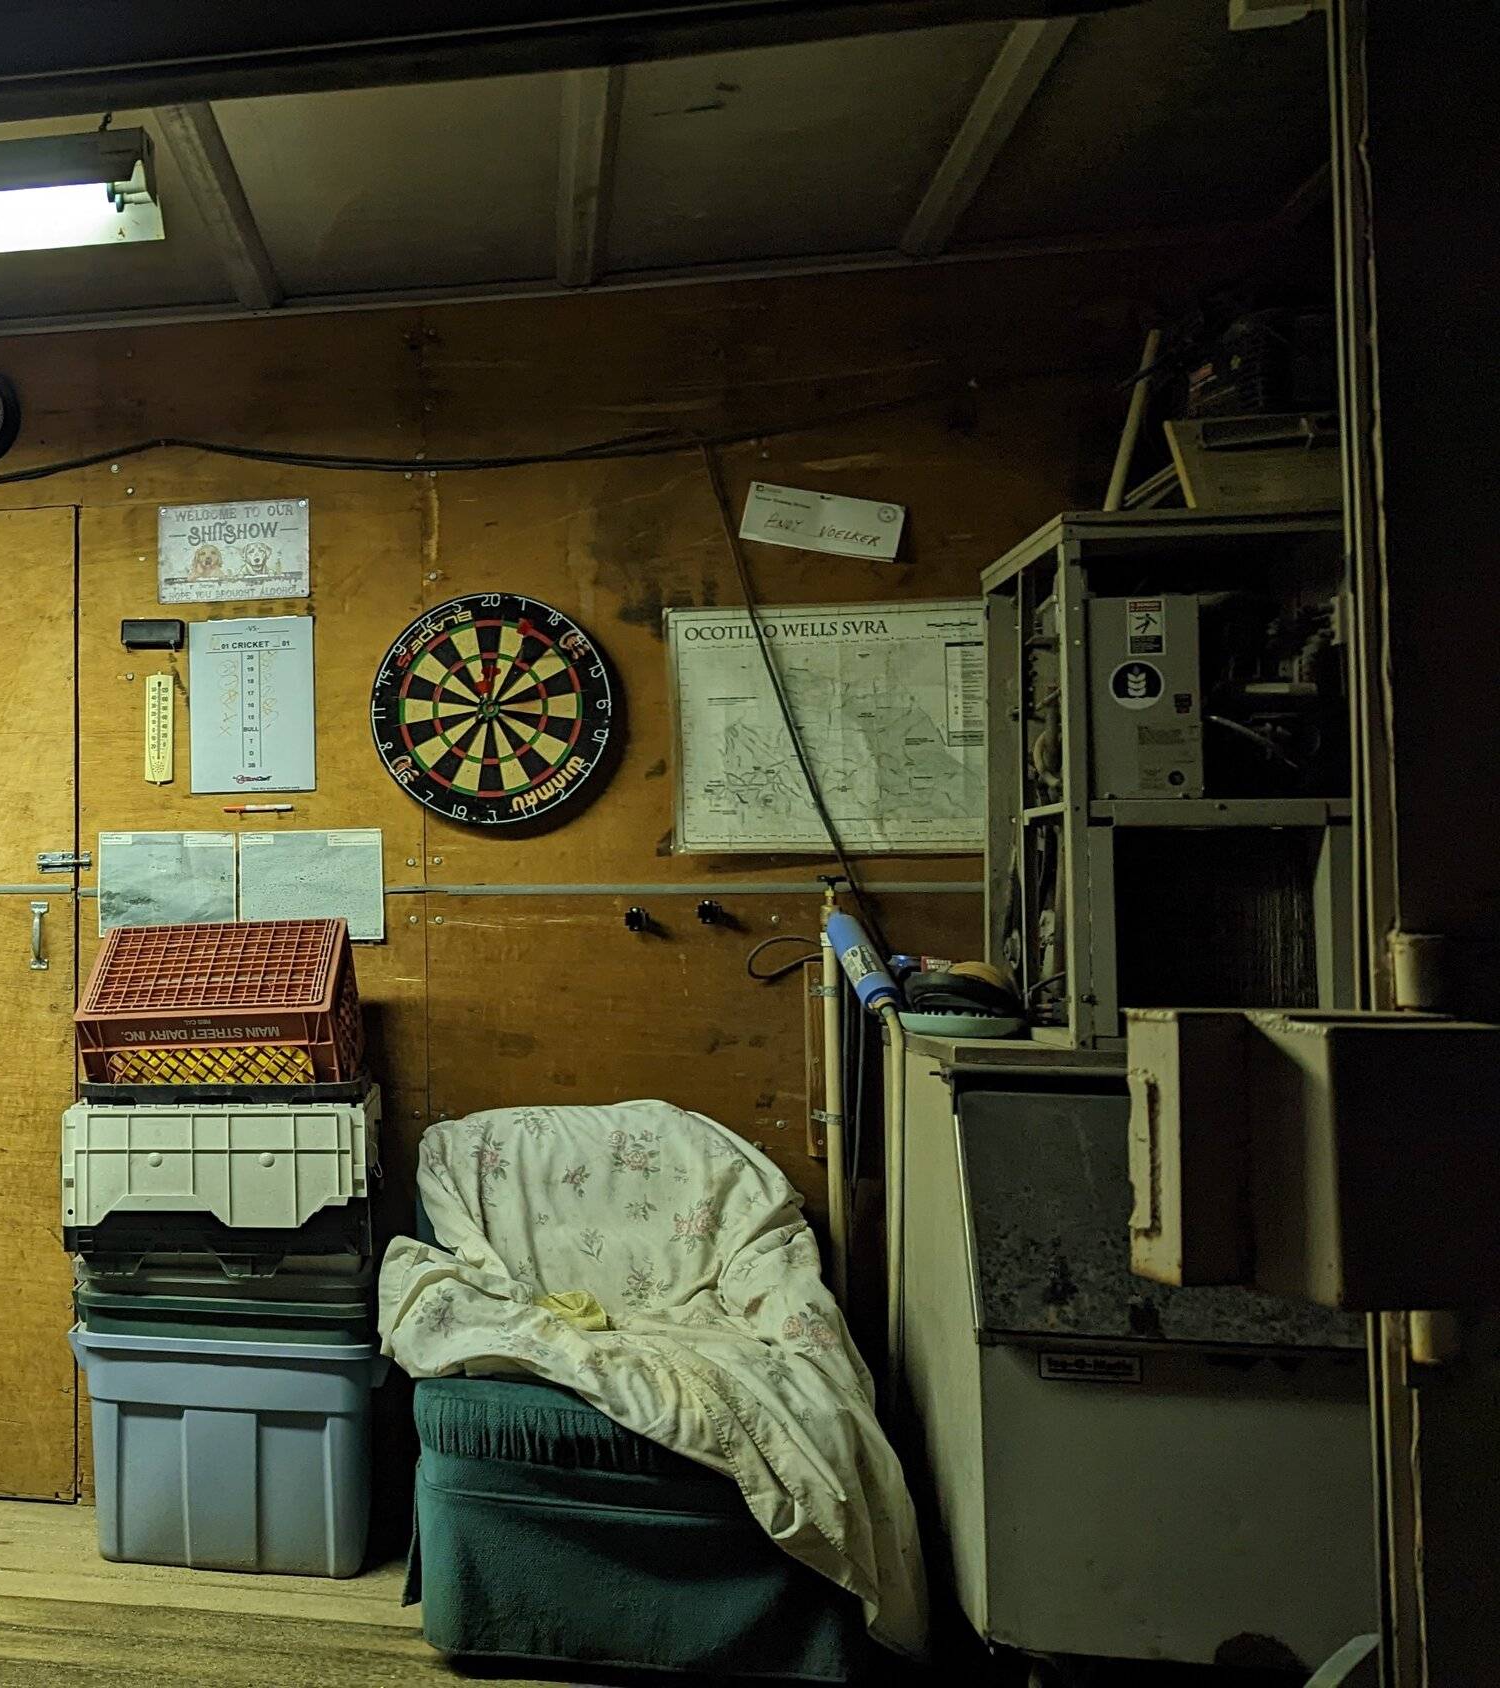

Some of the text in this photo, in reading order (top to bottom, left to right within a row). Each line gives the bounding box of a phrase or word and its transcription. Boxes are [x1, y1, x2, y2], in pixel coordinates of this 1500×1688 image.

[175, 504, 293, 522] WELCOME TO OUR
[188, 521, 278, 546] SHITSHOW
[820, 525, 881, 547] VOELKER
[196, 590, 212, 599] YOU
[481, 593, 500, 607] 20
[547, 609, 563, 626] 18
[411, 610, 473, 655] BLADE
[685, 620, 889, 641] OCOTILO WELLS SVRA
[231, 640, 270, 649] CRICKET
[378, 669, 394, 686] 14
[591, 728, 608, 744] 10
[511, 756, 585, 812] WINMAU
[451, 803, 468, 820] 19
[121, 1026, 280, 1042] MAIN STREET DAIRY INC.
